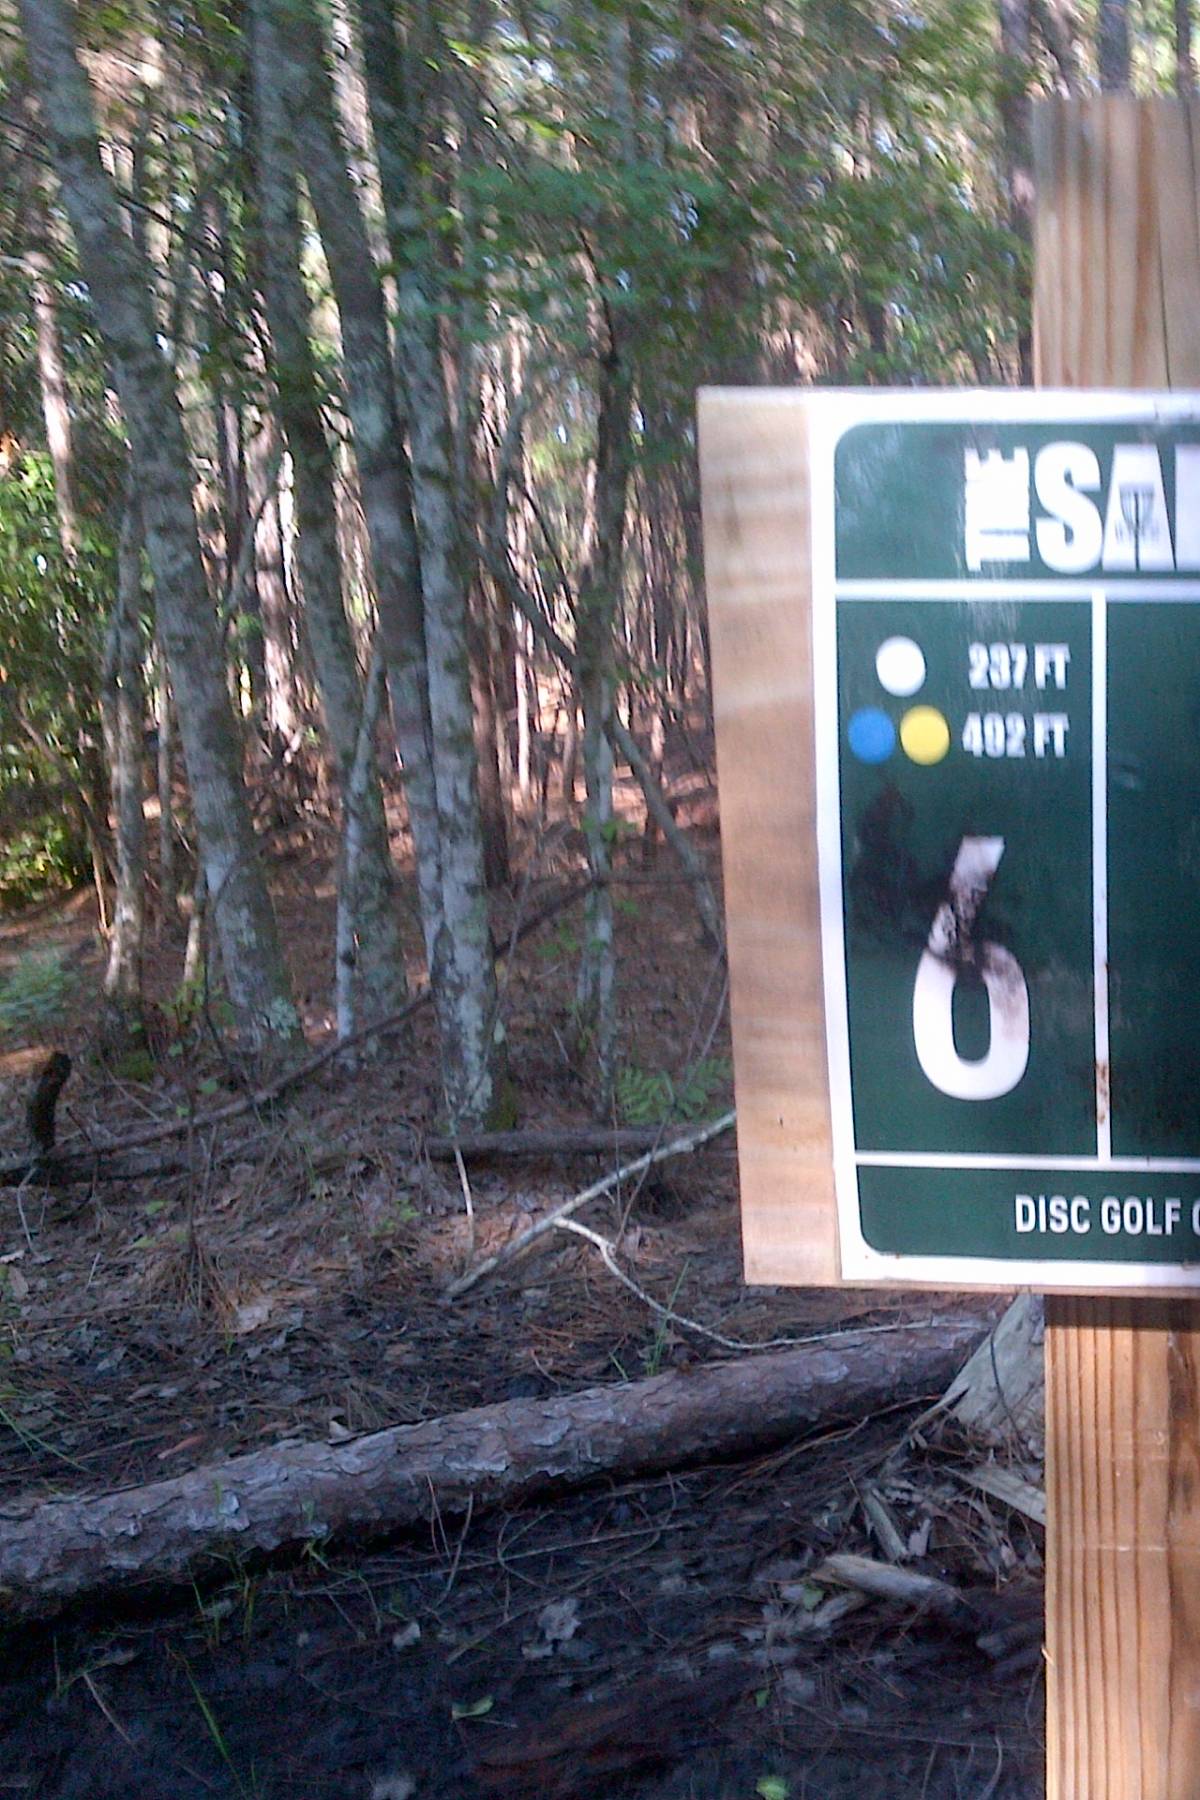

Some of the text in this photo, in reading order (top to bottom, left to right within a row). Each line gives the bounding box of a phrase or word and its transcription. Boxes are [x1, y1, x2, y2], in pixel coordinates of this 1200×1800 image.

[1034, 642, 1071, 690] FT
[962, 712, 1070, 758] 402 FT
[912, 836, 1030, 1101] 6
[1014, 1194, 1091, 1233] DISC
[1101, 1195, 1182, 1236] GOLF
